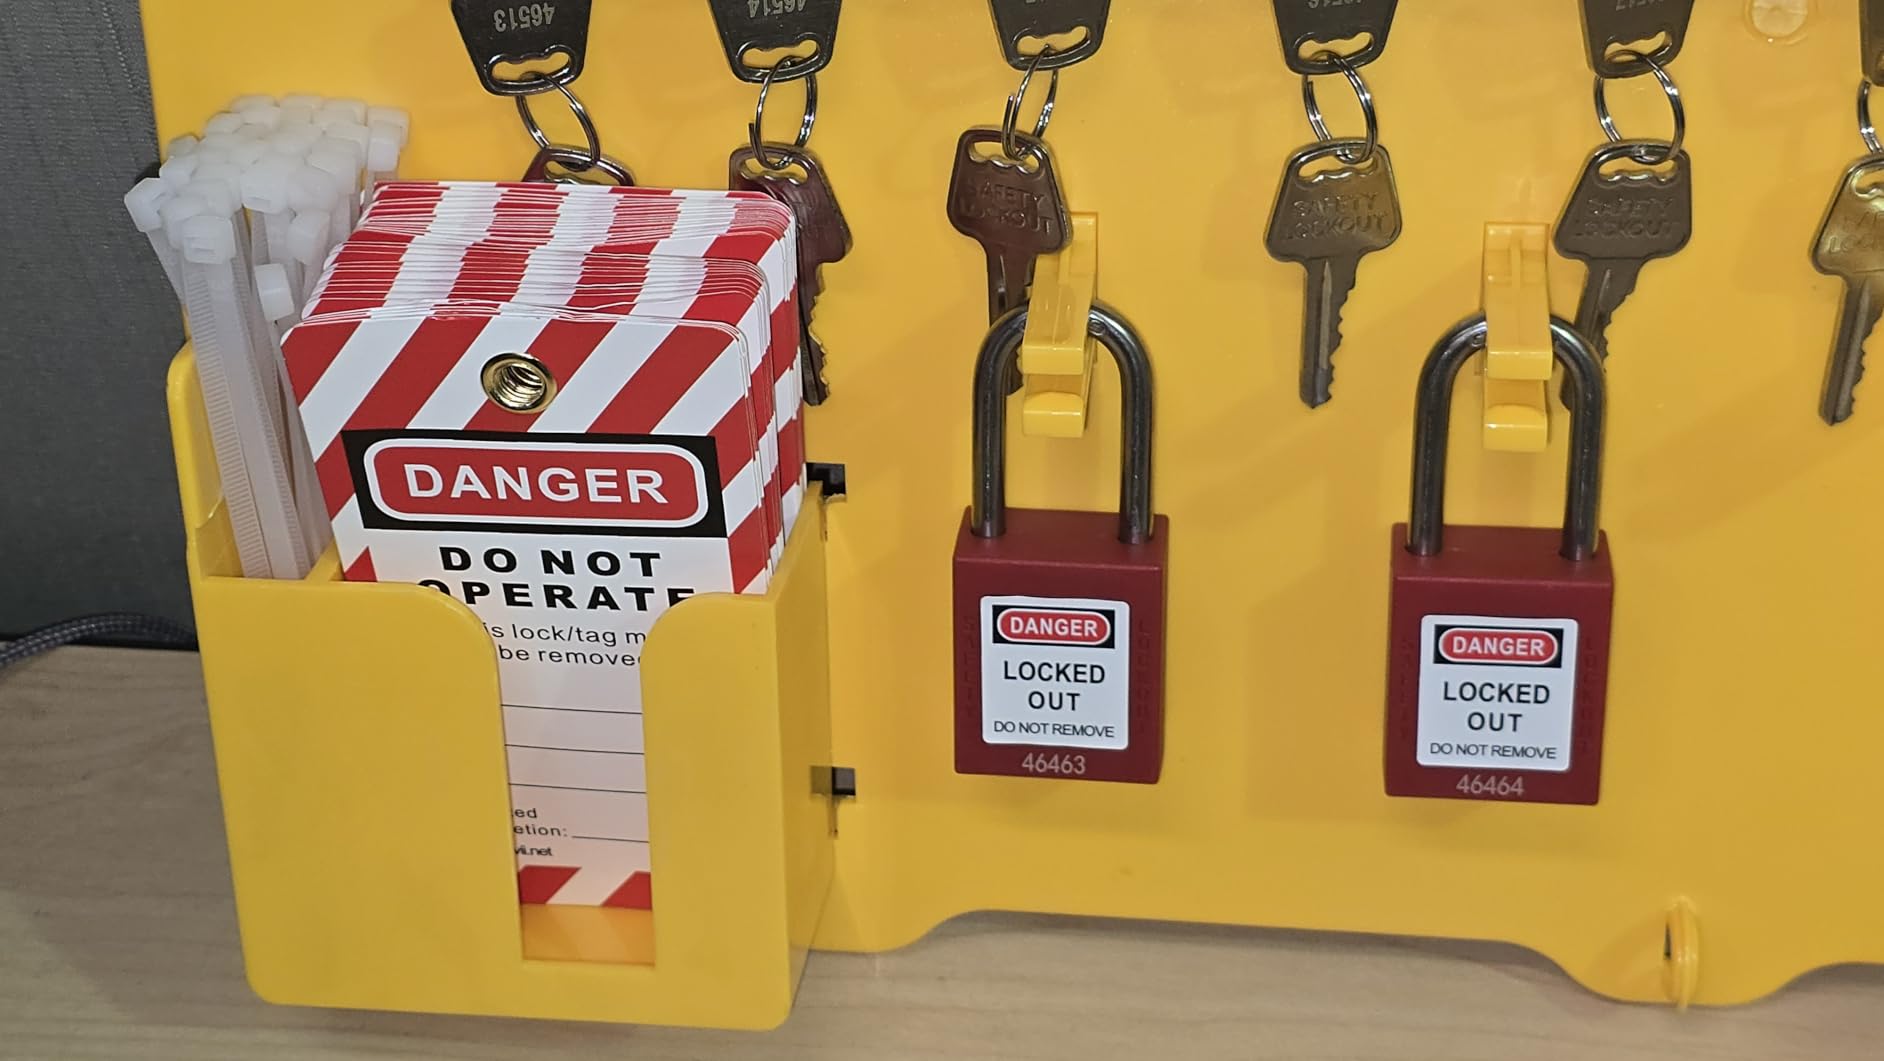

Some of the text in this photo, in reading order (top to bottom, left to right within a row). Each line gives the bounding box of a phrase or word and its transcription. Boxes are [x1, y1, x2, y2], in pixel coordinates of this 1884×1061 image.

[493, 2, 556, 33] 46513
[404, 462, 669, 504] DANGER
[439, 546, 661, 577] DO NOT
[511, 623, 616, 647] lock/tag
[1010, 616, 1098, 638] DANGER
[498, 644, 641, 667] be remove
[1453, 636, 1545, 657] DANGER
[1004, 660, 1106, 684] LOCKED
[1028, 691, 1081, 711] OUT
[1443, 681, 1550, 705] LOCKED
[994, 721, 1114, 738] DO NOT REMOVE
[1467, 712, 1523, 732] OUT
[1430, 742, 1557, 759] DO NOT REMOVE
[1022, 752, 1086, 774] 46463
[1456, 774, 1524, 796] 46464
[513, 824, 567, 836] etion:
